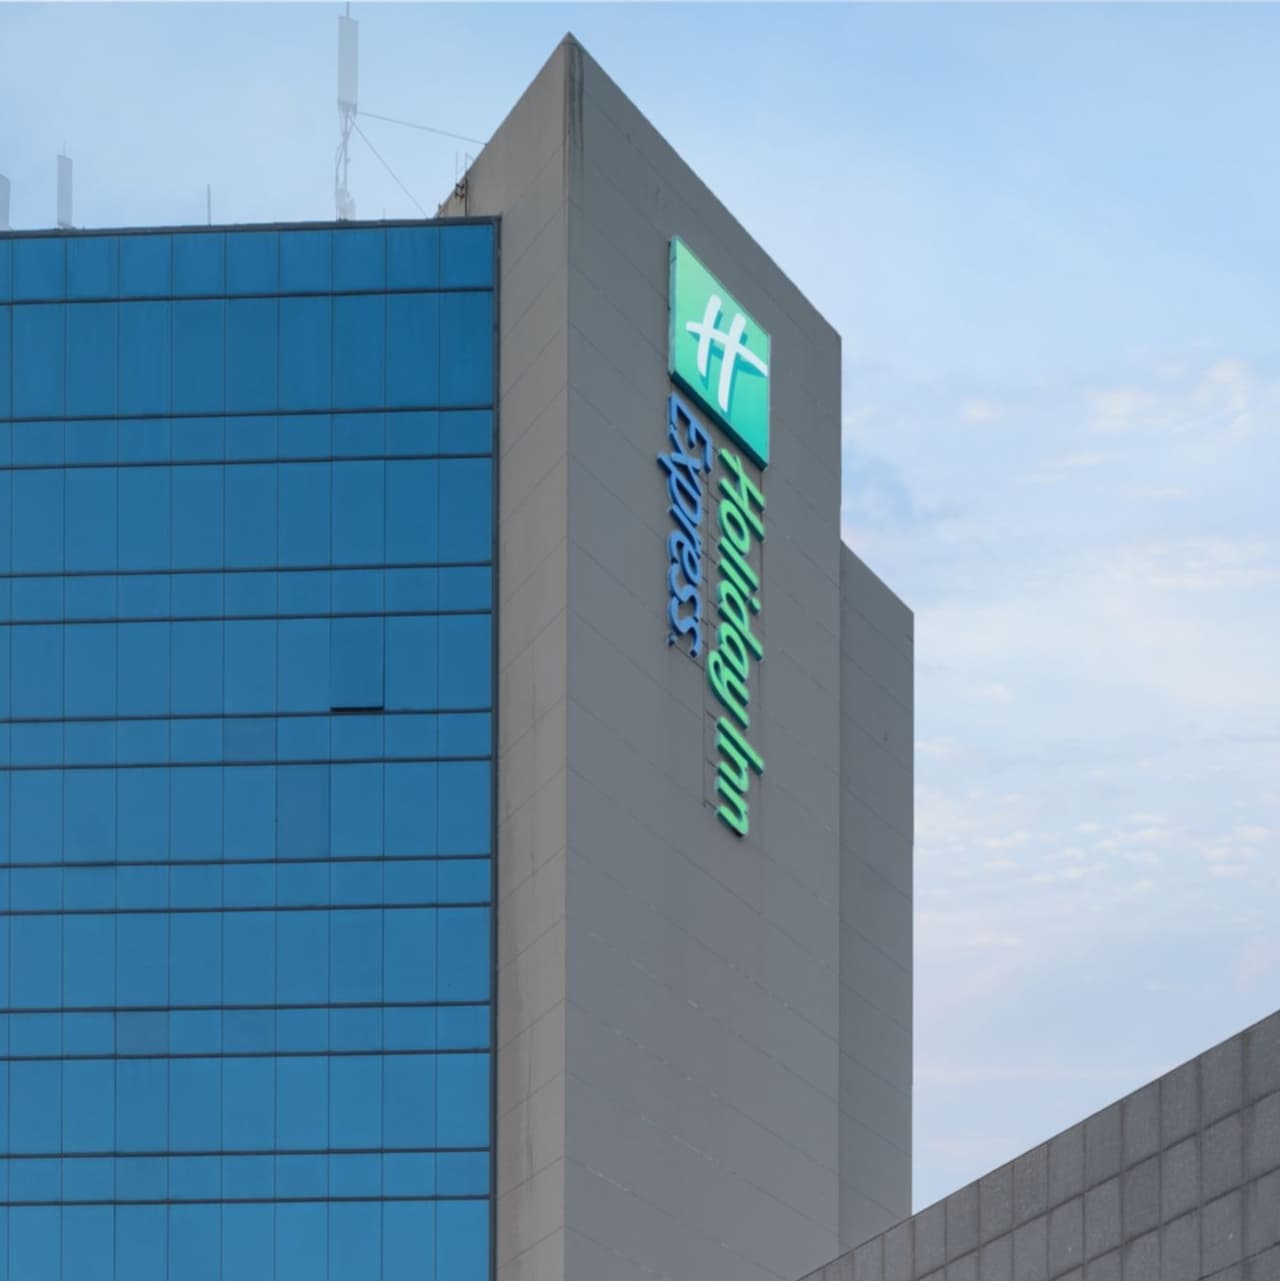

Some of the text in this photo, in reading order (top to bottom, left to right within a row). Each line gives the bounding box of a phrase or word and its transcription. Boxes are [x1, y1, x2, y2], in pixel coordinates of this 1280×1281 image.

[658, 394, 712, 659] Express
[708, 448, 766, 838] Holiday Inn
